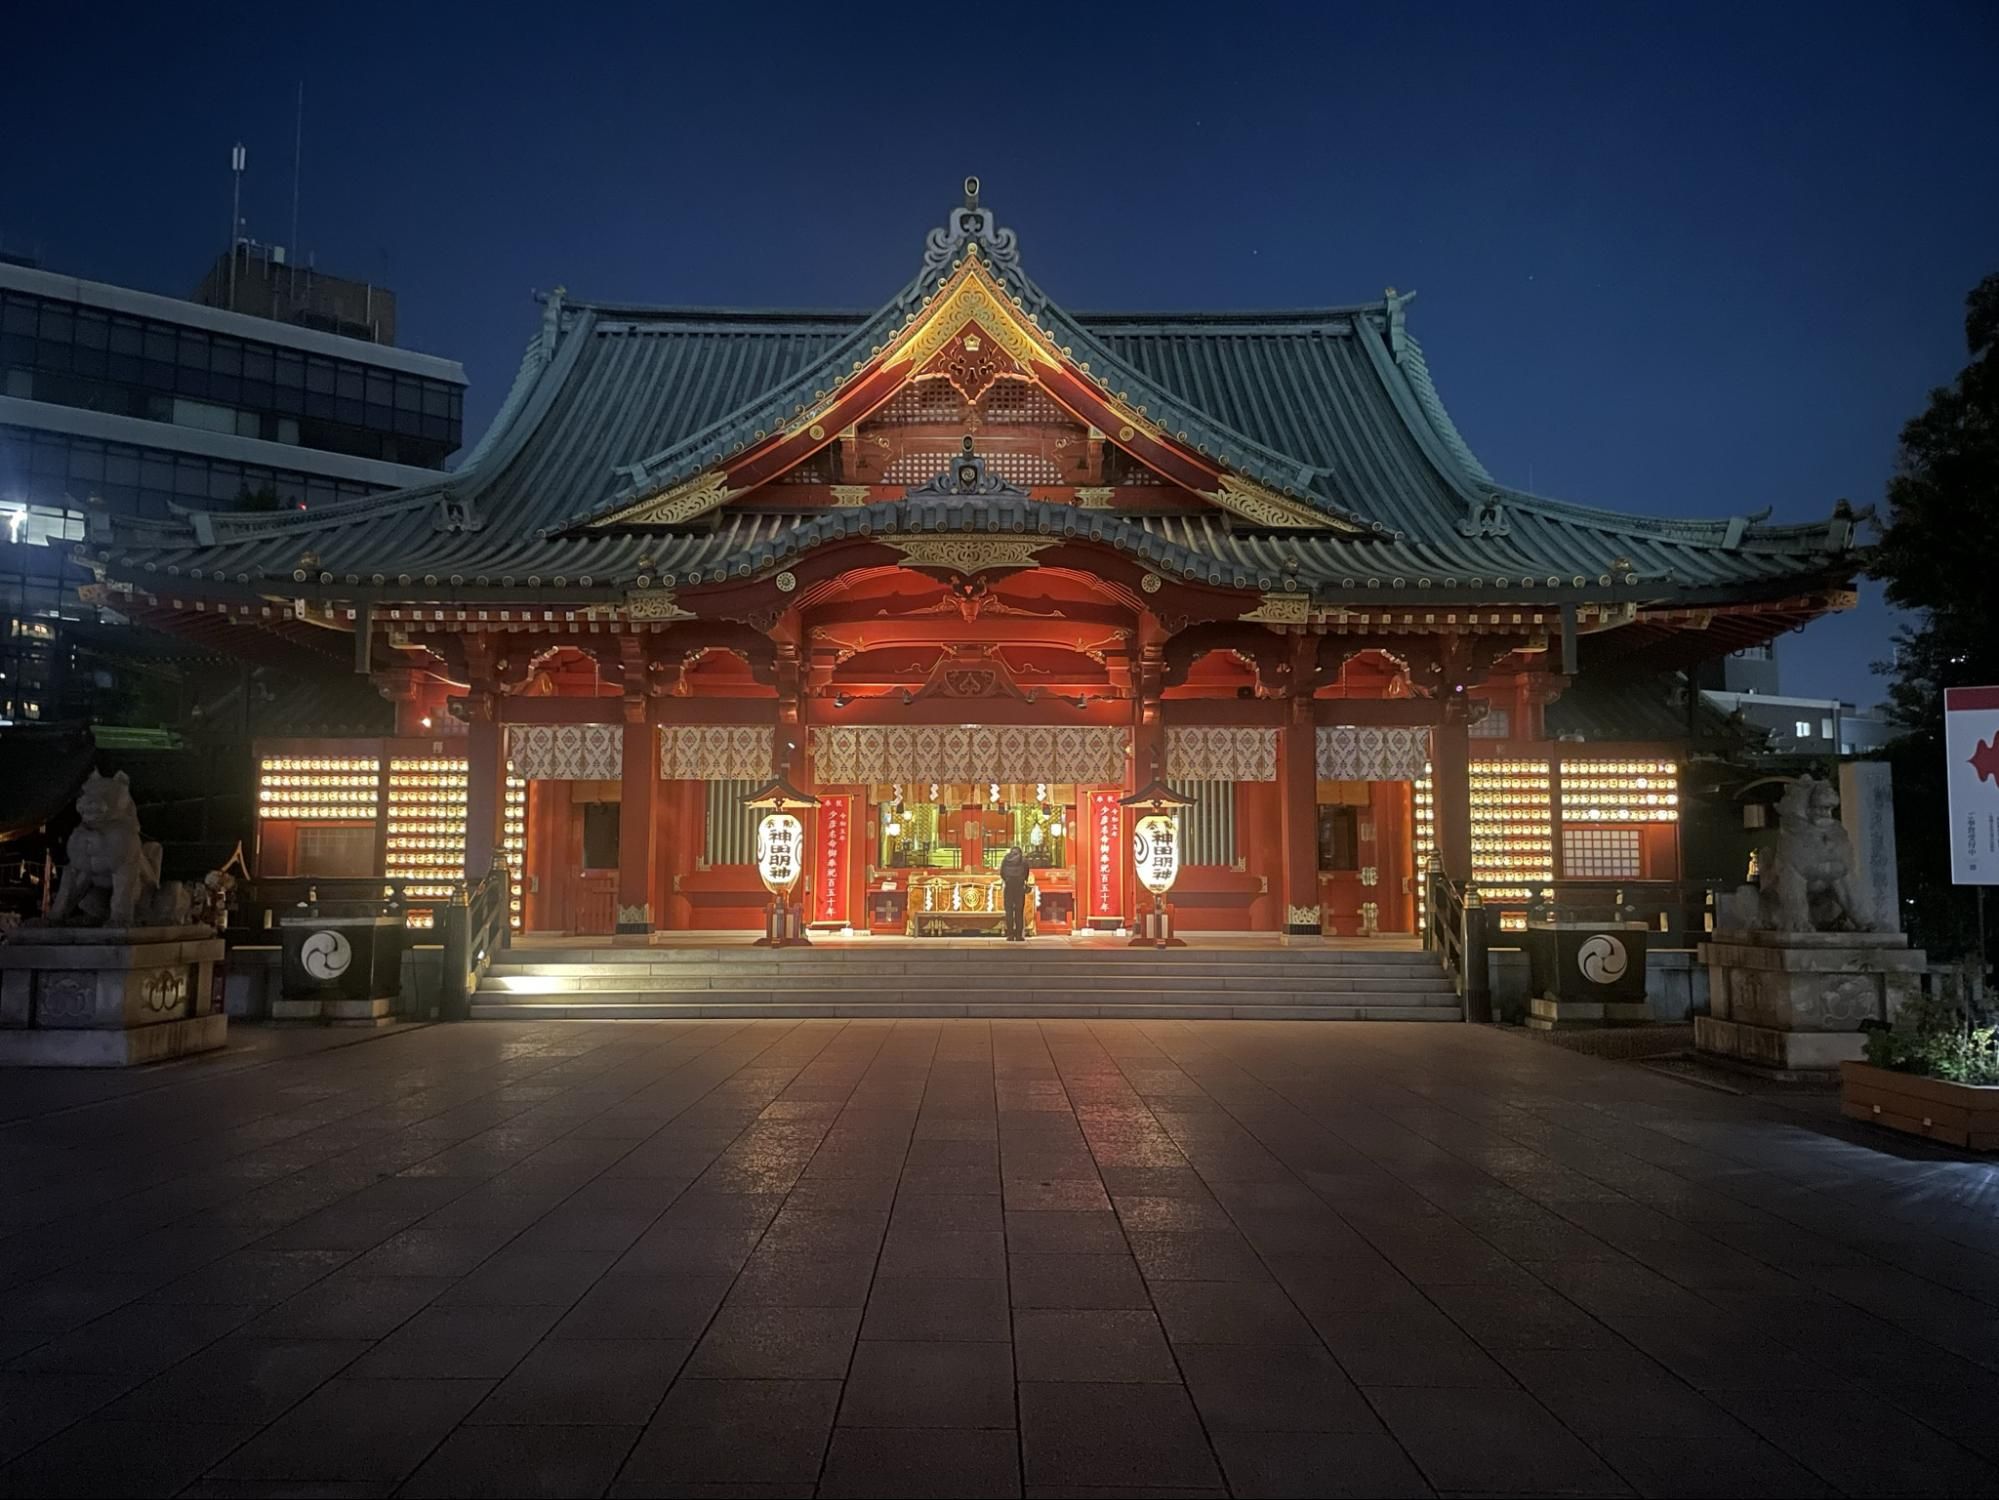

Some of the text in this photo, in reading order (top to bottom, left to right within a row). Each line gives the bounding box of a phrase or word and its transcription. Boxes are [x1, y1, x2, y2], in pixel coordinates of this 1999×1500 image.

[768, 829, 791, 879] 神田明神
[1151, 829, 1173, 881] 神田明神
